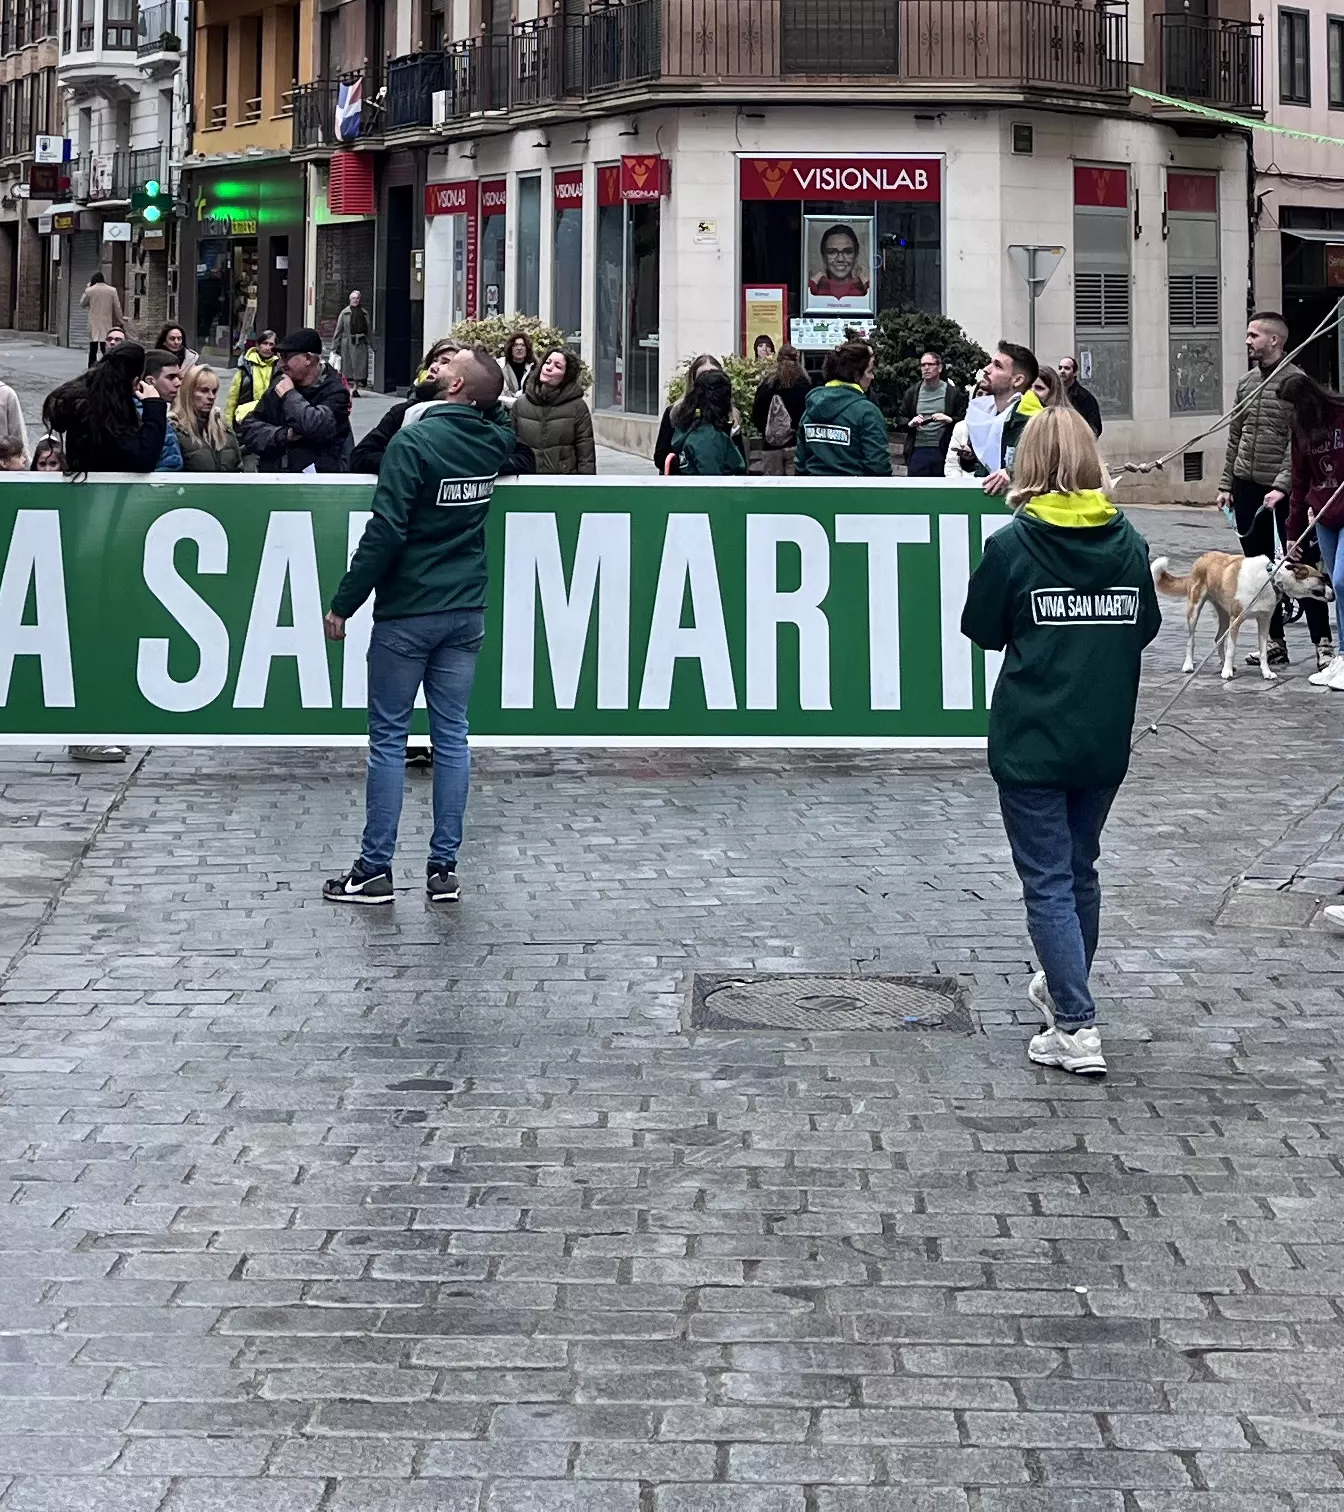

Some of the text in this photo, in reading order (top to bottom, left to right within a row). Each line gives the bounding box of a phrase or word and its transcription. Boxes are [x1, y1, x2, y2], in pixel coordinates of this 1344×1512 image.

[793, 168, 928, 190] VISIONLAB
[437, 189, 466, 208] VISIONLAB
[622, 190, 659, 198] VISIONLAB
[443, 484, 461, 500] VIVA
[462, 483, 477, 500] SAN
[500, 512, 1015, 711] MARTI
[1037, 594, 1136, 617] VIVA SAN MARTIN
